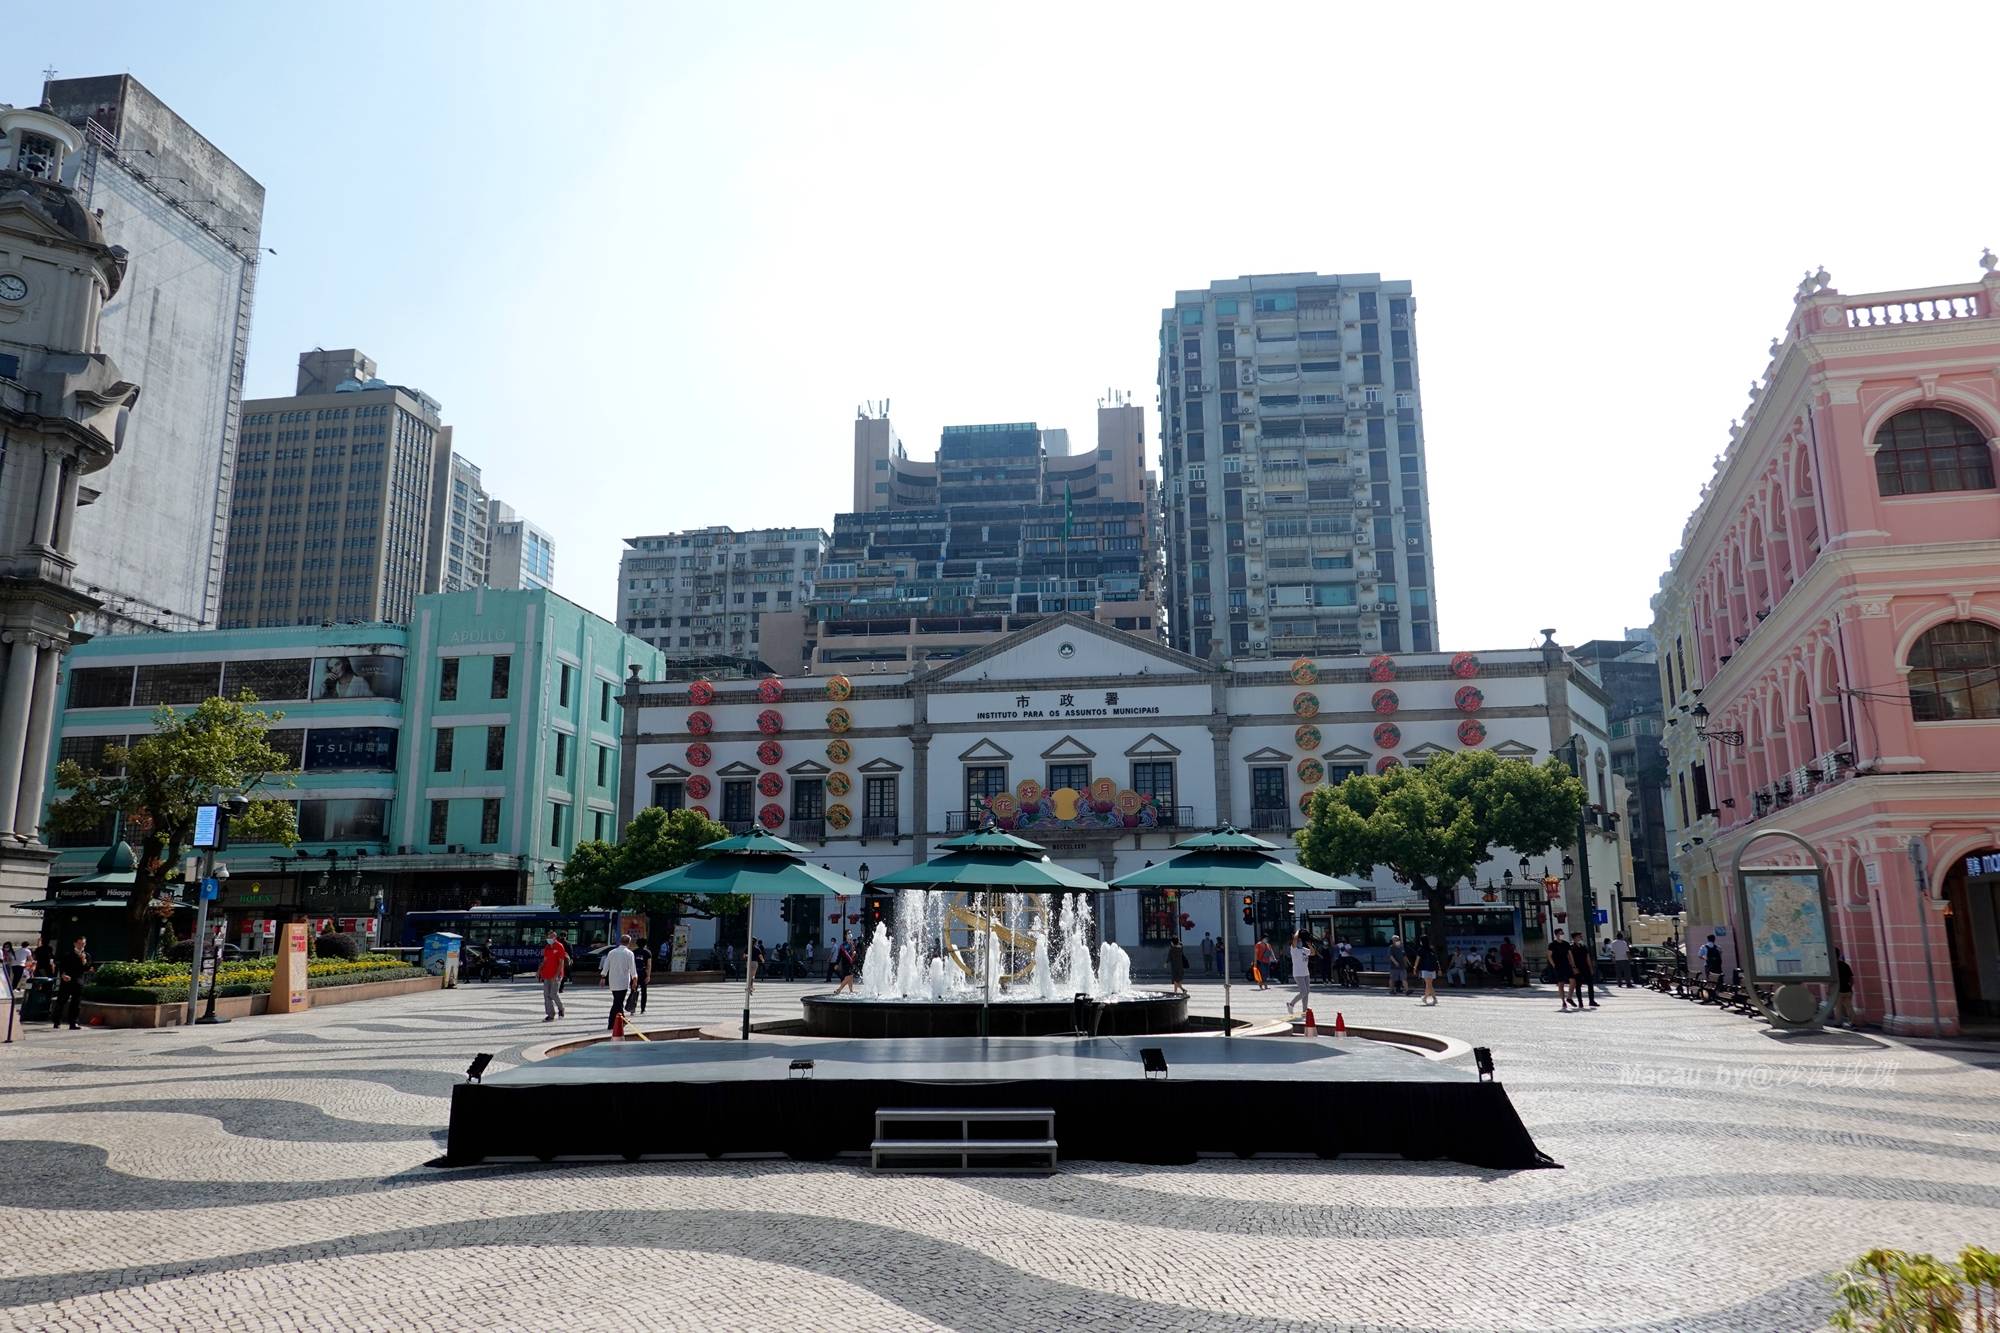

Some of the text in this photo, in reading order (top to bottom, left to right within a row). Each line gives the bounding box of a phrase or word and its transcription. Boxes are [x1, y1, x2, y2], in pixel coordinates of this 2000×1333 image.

[451, 628, 507, 643] APOLLO
[1016, 692, 1120, 708] 市政署
[977, 707, 1160, 720] INSTITUTO PARA OS ASSUNTOS MUNICIPAIS
[316, 744, 346, 753] TSL
